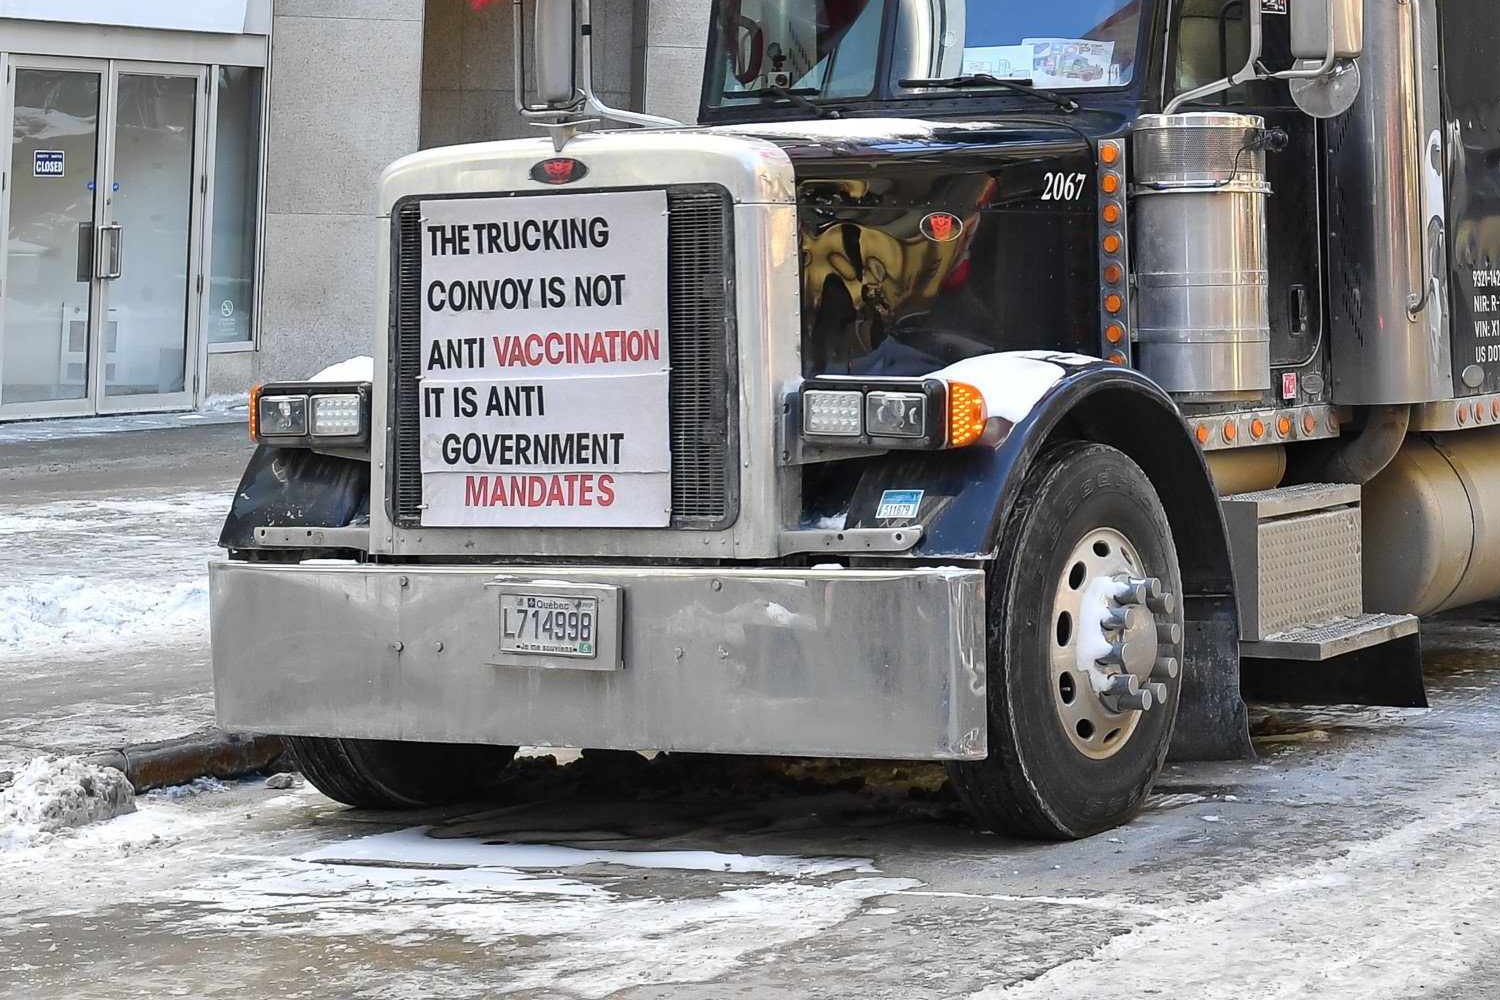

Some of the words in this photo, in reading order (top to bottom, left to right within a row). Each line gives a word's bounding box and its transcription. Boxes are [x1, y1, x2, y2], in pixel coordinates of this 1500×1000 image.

[36, 161, 63, 172] CLOSED
[1041, 172, 1086, 200] 2067
[427, 225, 470, 256] THE
[473, 217, 609, 254] TRUCKING
[427, 277, 533, 312] CONVOY
[540, 276, 566, 308] IS
[575, 274, 626, 307] NOT
[1474, 295, 1490, 312] NIR:
[1474, 320, 1490, 338] VIN:
[427, 338, 485, 370] ANTI
[493, 329, 659, 367] VACCINATION
[1475, 346, 1486, 363] US
[424, 387, 444, 418] IT
[454, 387, 478, 418] IS
[485, 385, 545, 417] ANTI
[442, 433, 624, 465] GOVERNMENT
[465, 474, 615, 507] MANDATES
[503, 608, 592, 641] L714998
